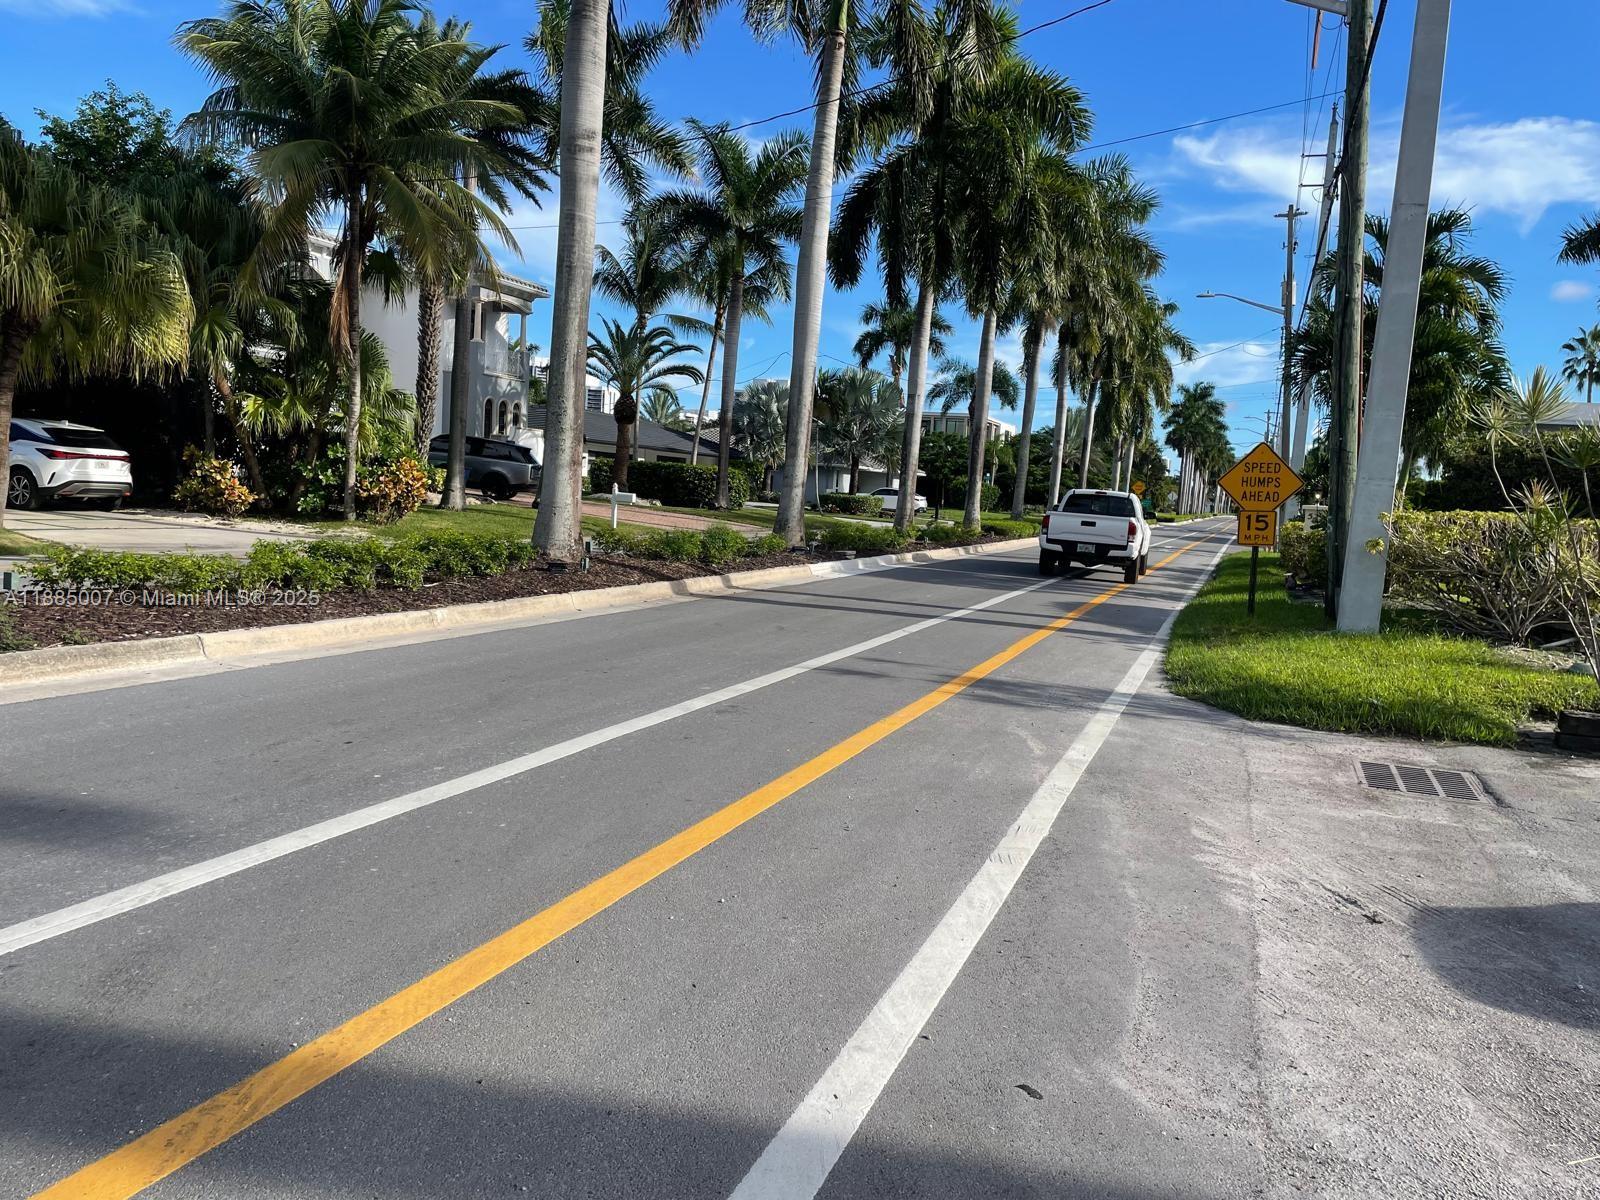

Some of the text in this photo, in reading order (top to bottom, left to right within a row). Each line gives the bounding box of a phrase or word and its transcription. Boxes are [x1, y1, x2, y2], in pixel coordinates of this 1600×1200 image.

[1244, 462, 1280, 474] SPEED
[1241, 477, 1281, 488] HUMPS
[1241, 491, 1280, 502] AHEAD
[1245, 514, 1269, 531] 15
